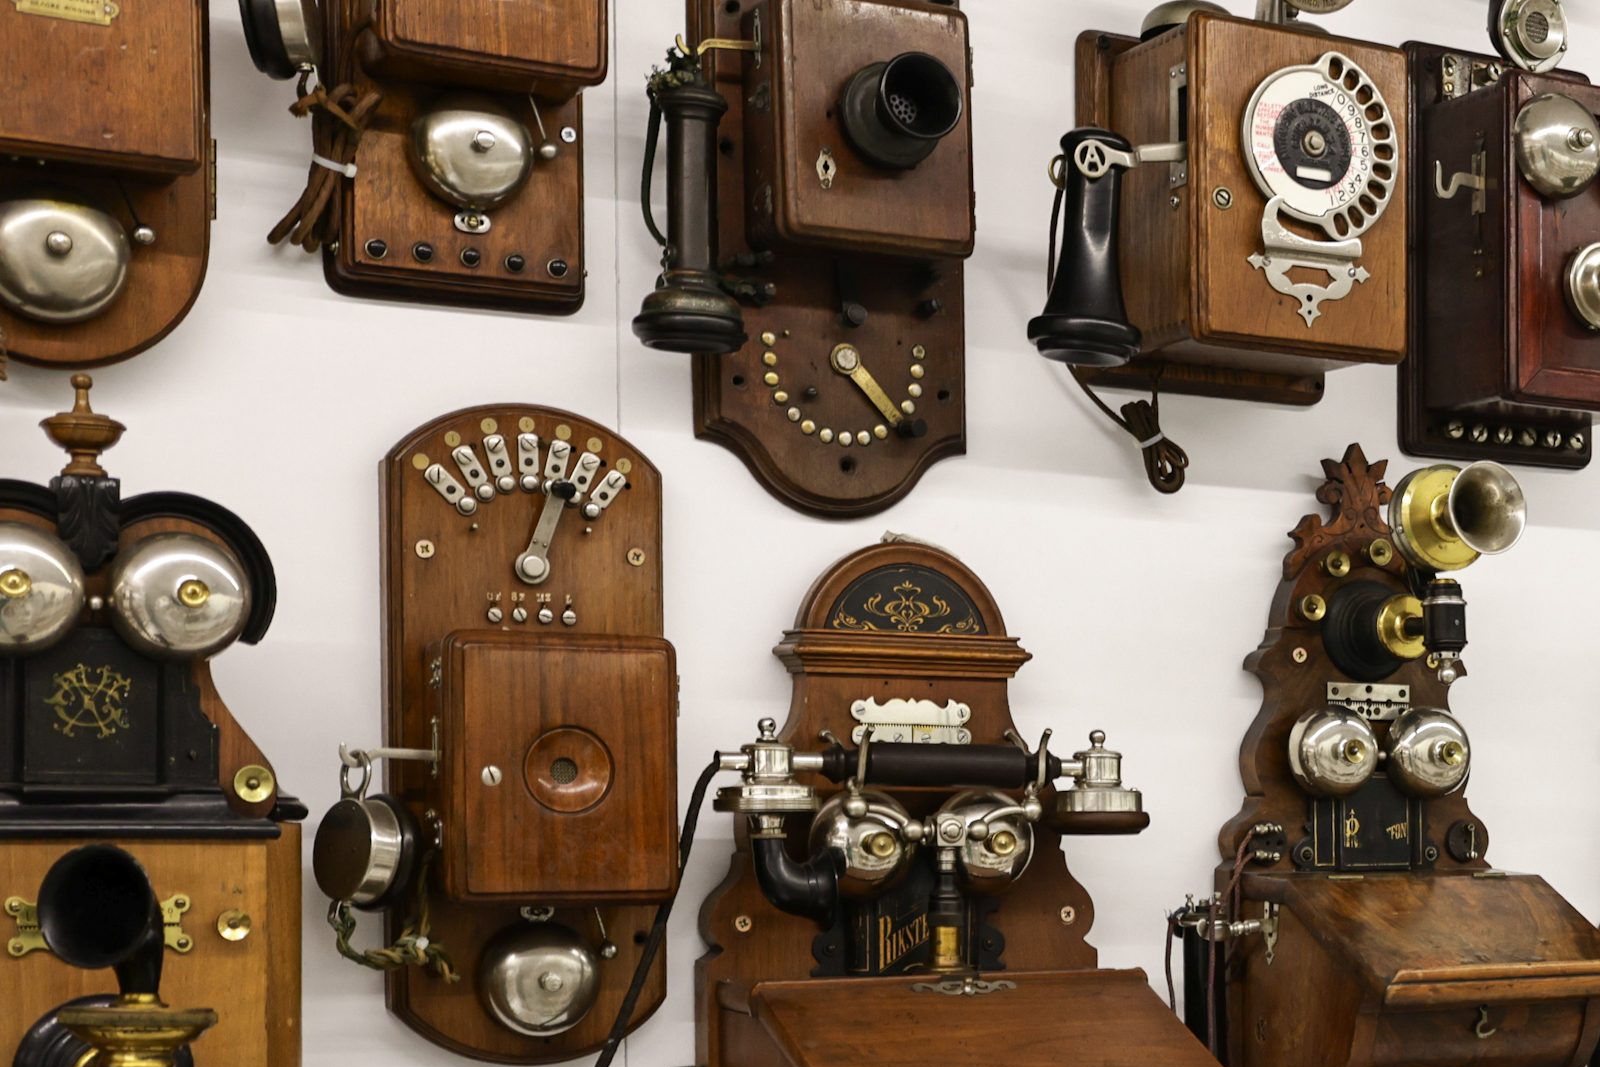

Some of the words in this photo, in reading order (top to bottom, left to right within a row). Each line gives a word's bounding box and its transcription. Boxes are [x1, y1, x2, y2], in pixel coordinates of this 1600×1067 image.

[1337, 93, 1345, 105] 0
[1347, 104, 1355, 116] 9
[1255, 124, 1274, 132] NUMBE
[1355, 117, 1362, 129] 8
[1255, 130, 1273, 138] WANTE
[1359, 131, 1366, 143] 7
[1361, 146, 1369, 157] 6
[1360, 160, 1368, 171] 5
[1354, 173, 1362, 185] 4
[1348, 182, 1356, 194] 3
[1338, 190, 1346, 201] 2
[879, 912, 930, 971] RIKSTE
